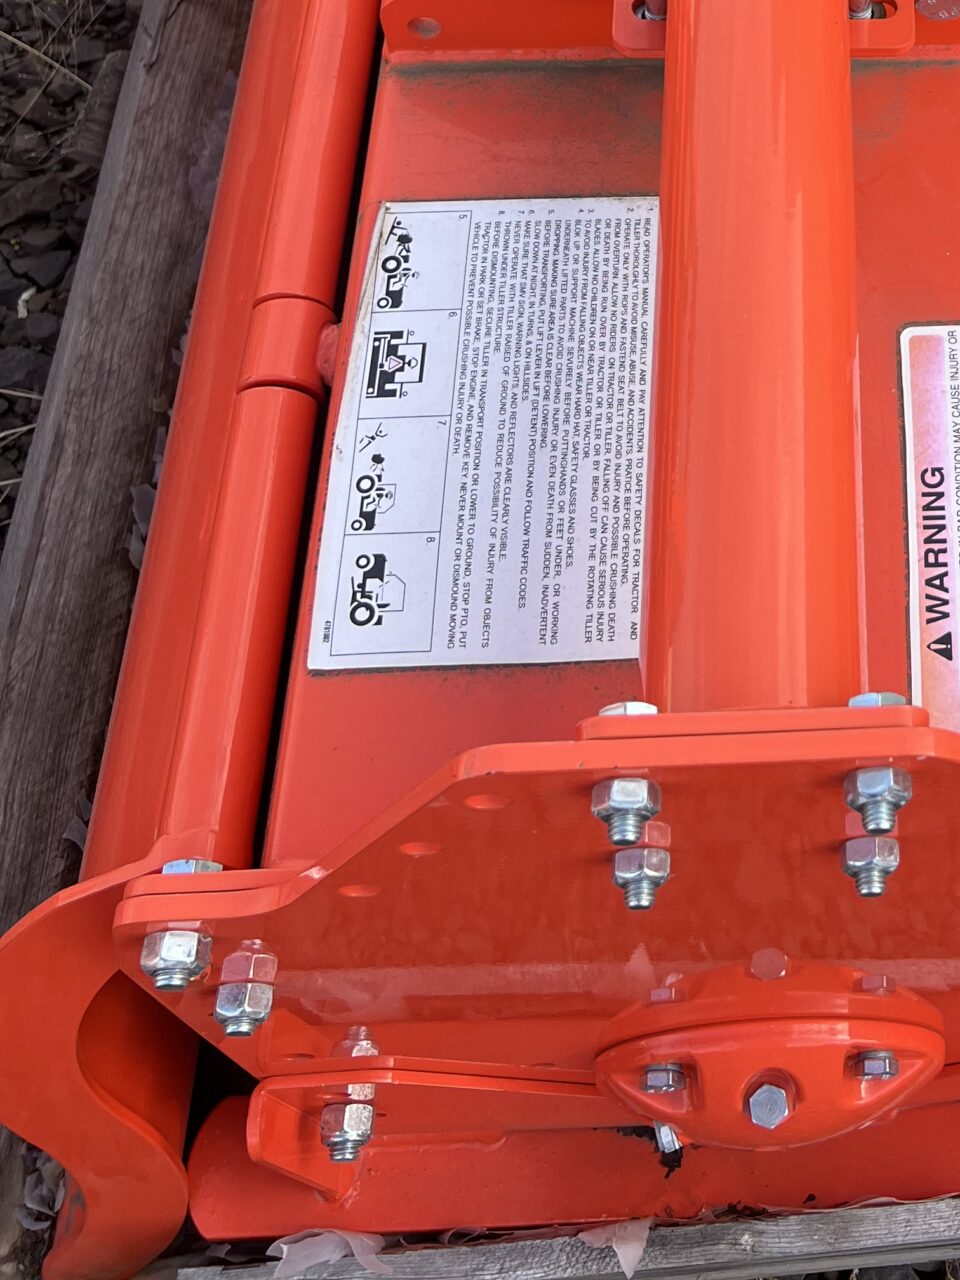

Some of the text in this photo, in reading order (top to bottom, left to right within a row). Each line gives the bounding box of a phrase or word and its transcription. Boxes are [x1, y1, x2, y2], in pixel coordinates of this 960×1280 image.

[573, 218, 581, 238] BLOK
[643, 217, 651, 237] READ
[572, 240, 580, 251] UP
[571, 252, 579, 265] OR
[946, 330, 957, 344] OR
[947, 346, 959, 381] INJURY
[638, 367, 646, 386] AND
[637, 388, 646, 404] PAY
[949, 383, 960, 418] CAUSE
[635, 456, 644, 469] TO
[556, 499, 566, 514] OR
[555, 517, 565, 540] FEET
[919, 466, 951, 625] WARNING
[631, 547, 641, 568] FOR
[551, 582, 561, 597] OR
[629, 620, 638, 641] AND
